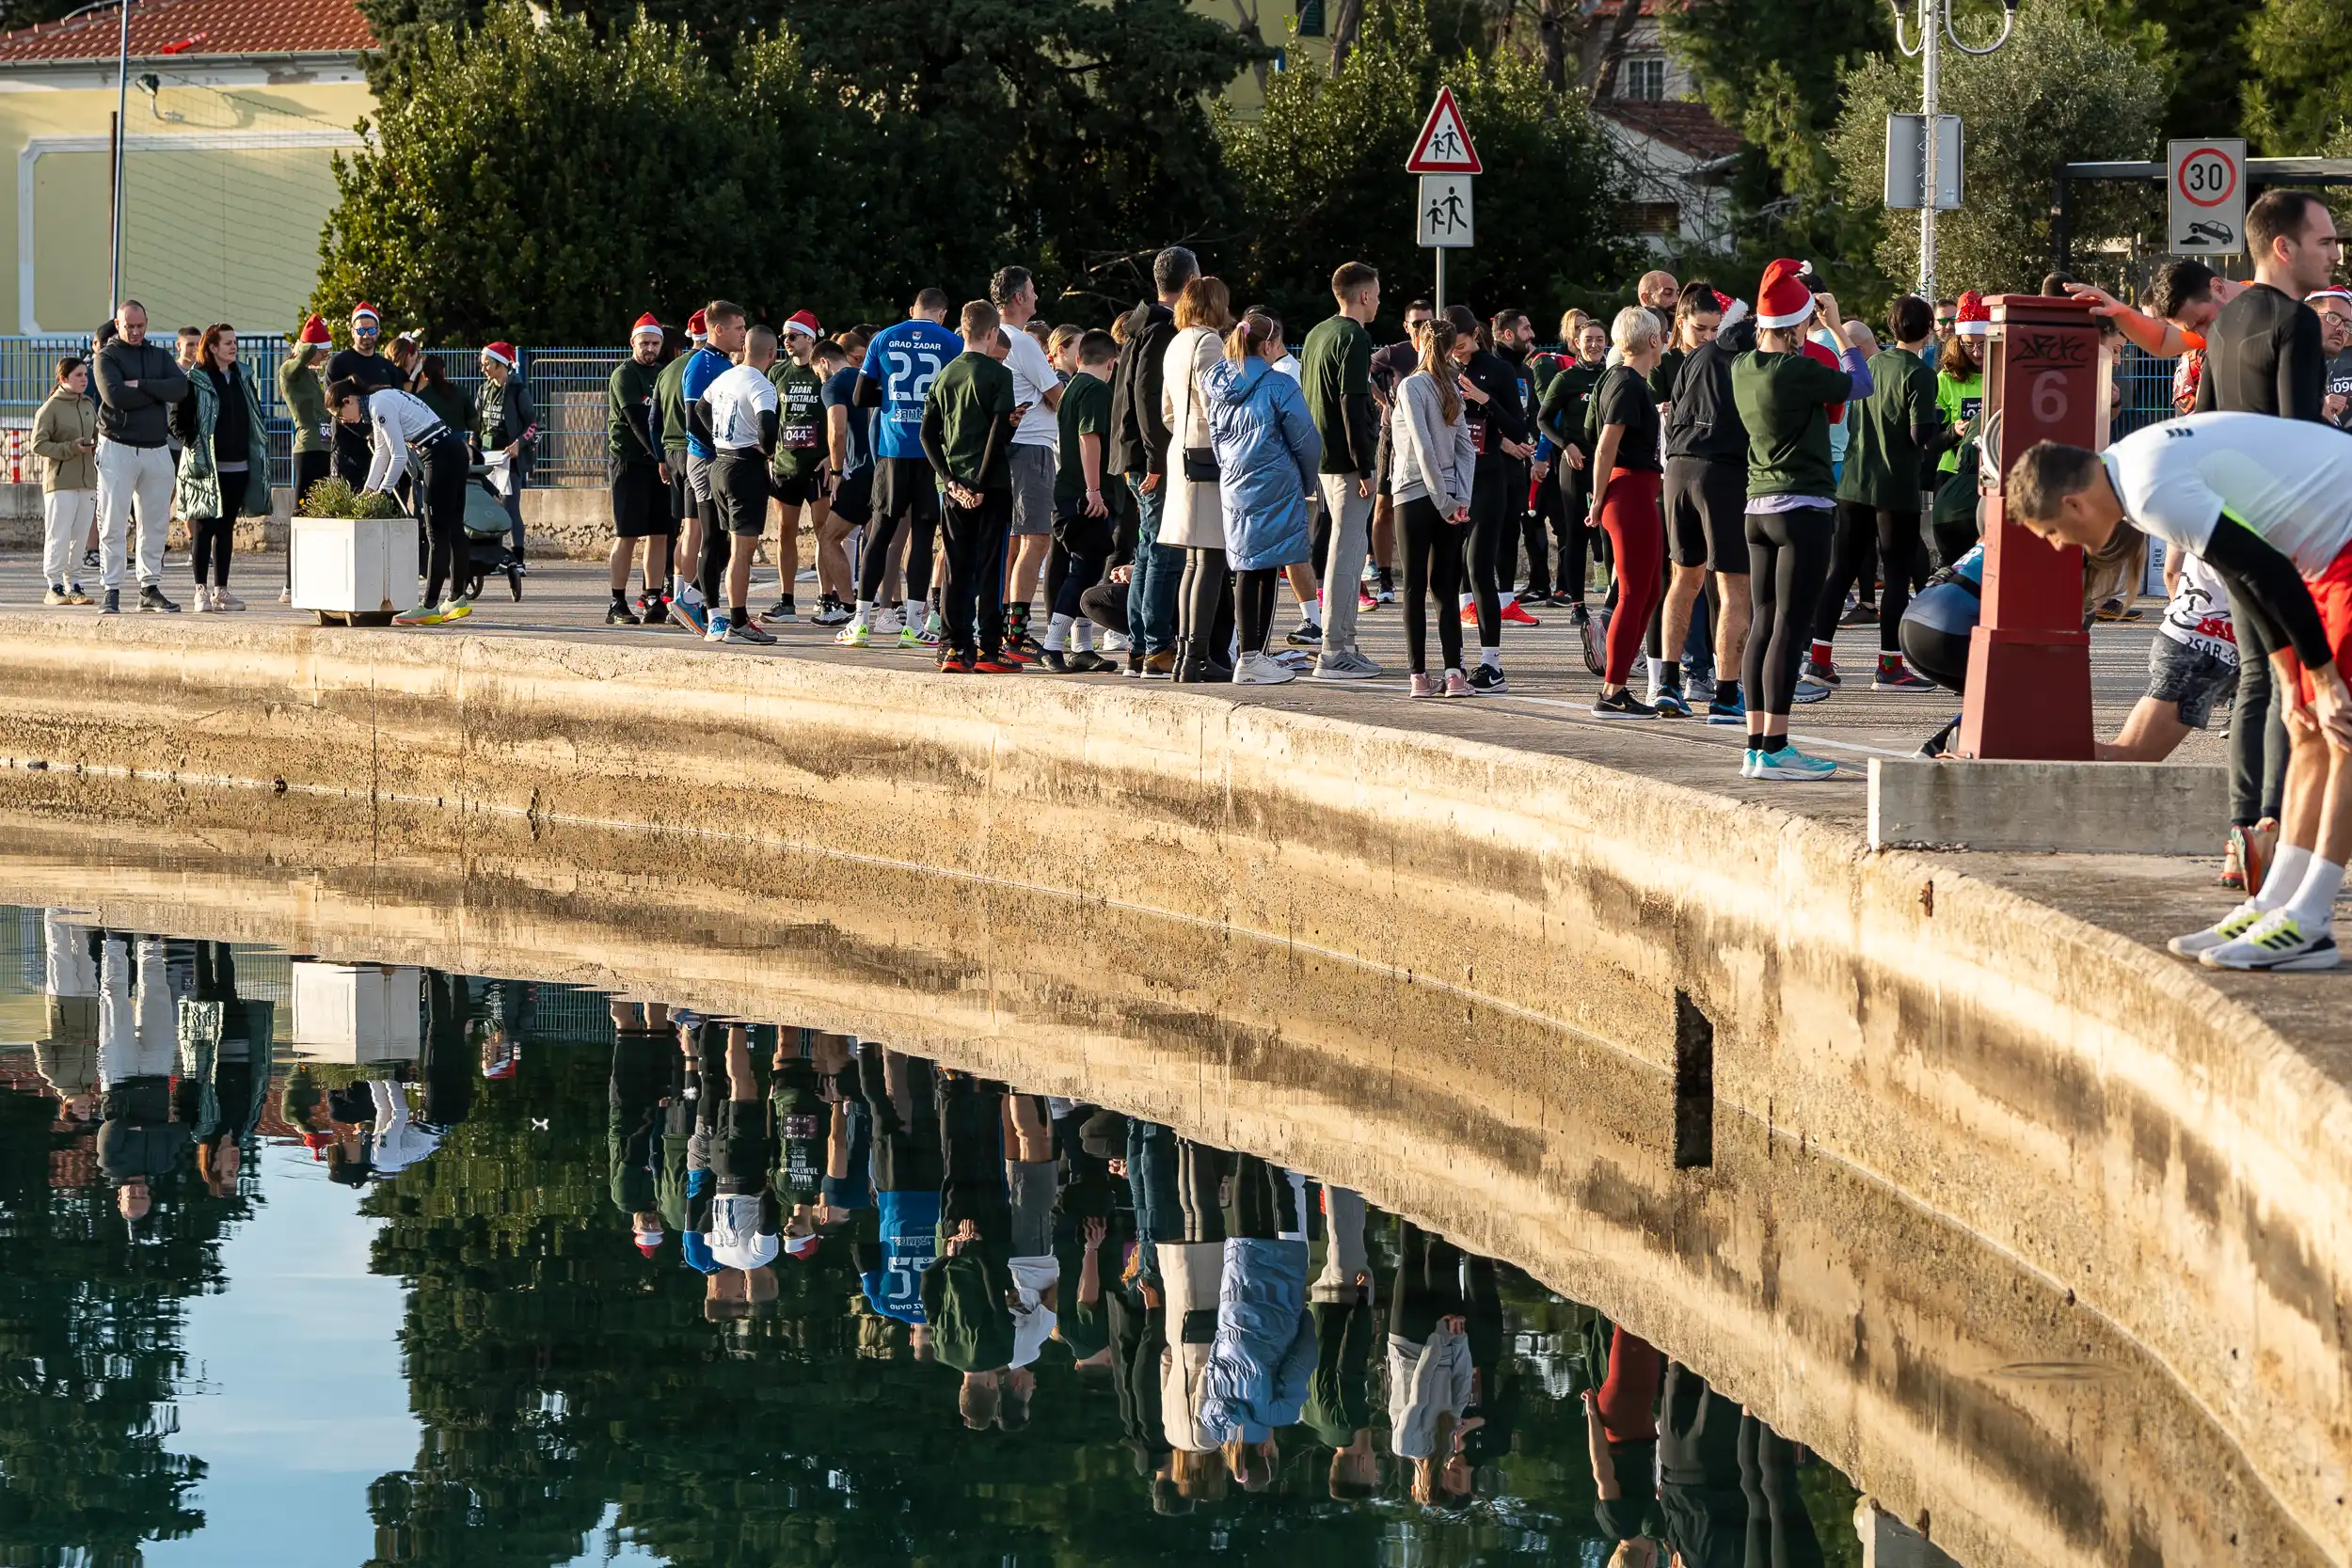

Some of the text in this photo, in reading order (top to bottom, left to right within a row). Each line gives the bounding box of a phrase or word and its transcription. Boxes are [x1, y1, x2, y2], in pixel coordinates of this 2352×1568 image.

[2190, 163, 2223, 192] 30
[887, 351, 942, 402] 22
[789, 385, 813, 394] ZADAR
[2031, 370, 2068, 423] 6
[790, 403, 806, 412] RUN
[895, 406, 924, 420] sant
[1020, 645, 1038, 655] HOKA
